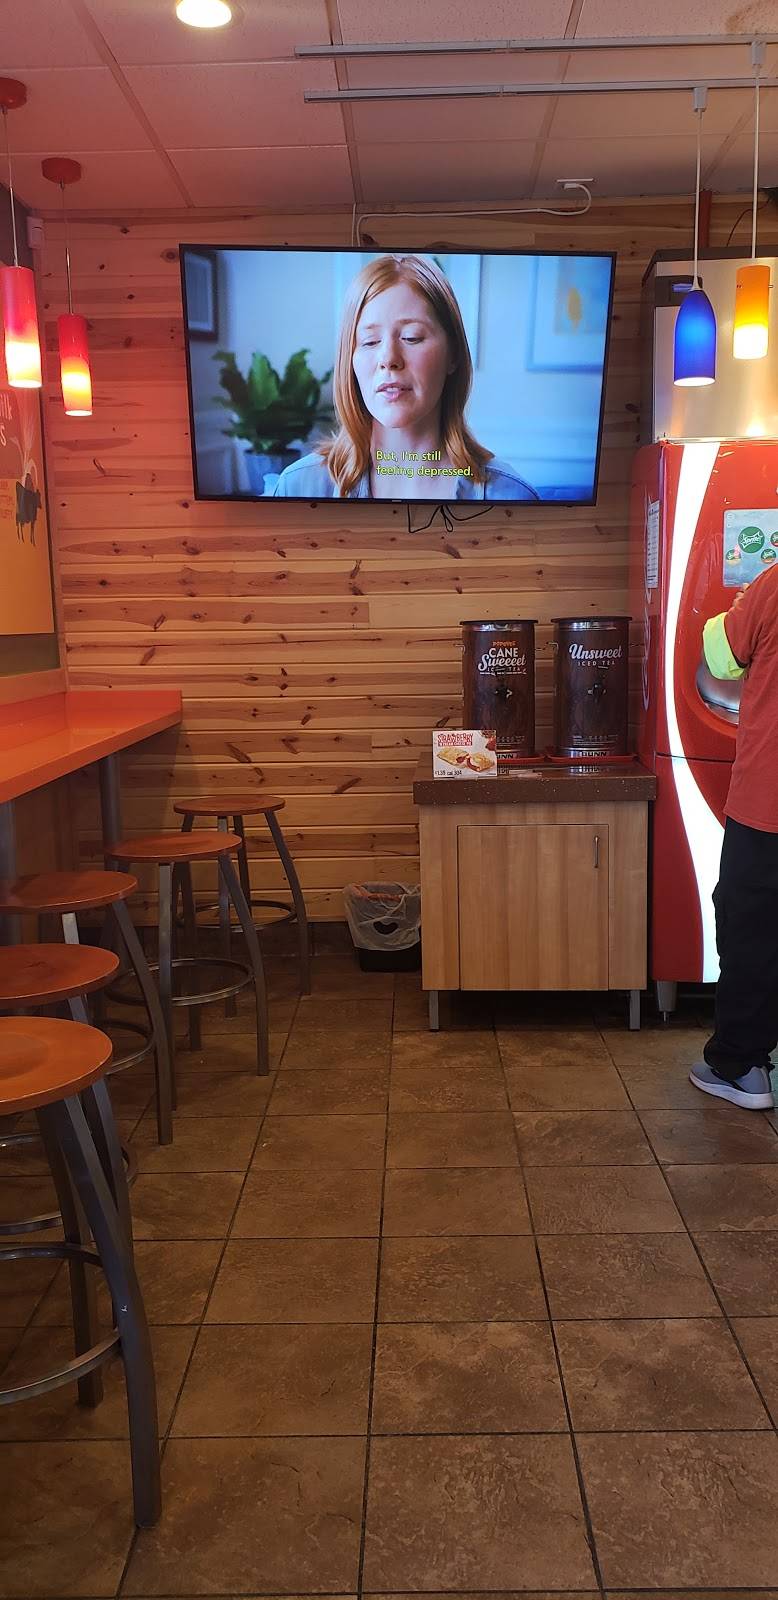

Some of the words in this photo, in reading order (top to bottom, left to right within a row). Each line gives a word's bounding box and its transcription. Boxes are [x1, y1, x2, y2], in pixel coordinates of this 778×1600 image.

[0, 393, 12, 420] ilk
[376, 451, 398, 462] But,
[402, 451, 418, 461] I'm
[422, 450, 441, 461] still
[376, 465, 414, 478] feeling
[417, 466, 474, 478] depressed.
[489, 648, 519, 658] CANE
[569, 643, 622, 660] Unsweet
